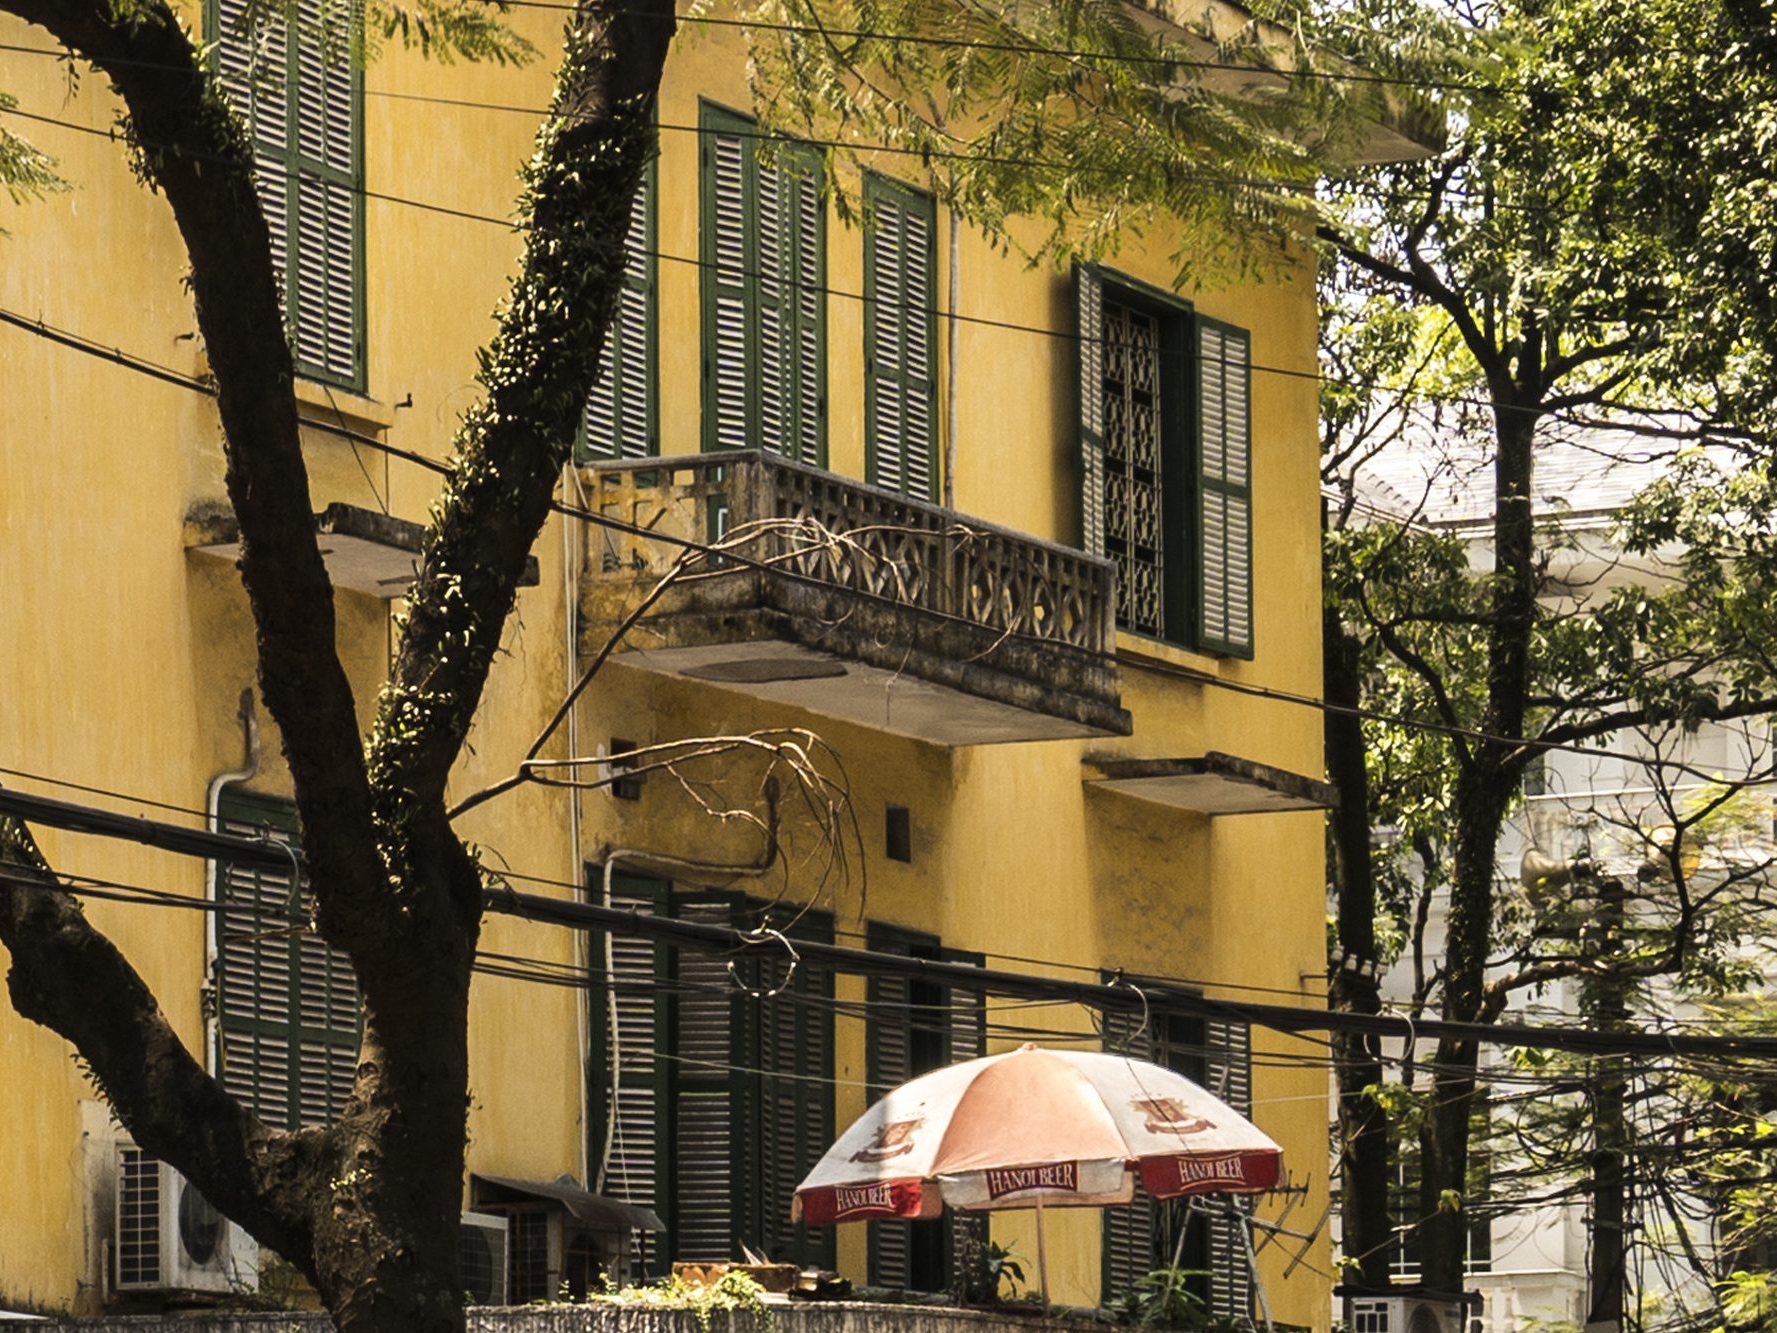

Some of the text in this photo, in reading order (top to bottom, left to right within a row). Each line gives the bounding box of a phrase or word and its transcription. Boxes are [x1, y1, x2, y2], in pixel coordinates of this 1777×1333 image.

[989, 1163, 1074, 1194] HANOI BEER
[1179, 1157, 1244, 1183] HANOI BEER
[836, 1183, 896, 1211] HANOI BEER
